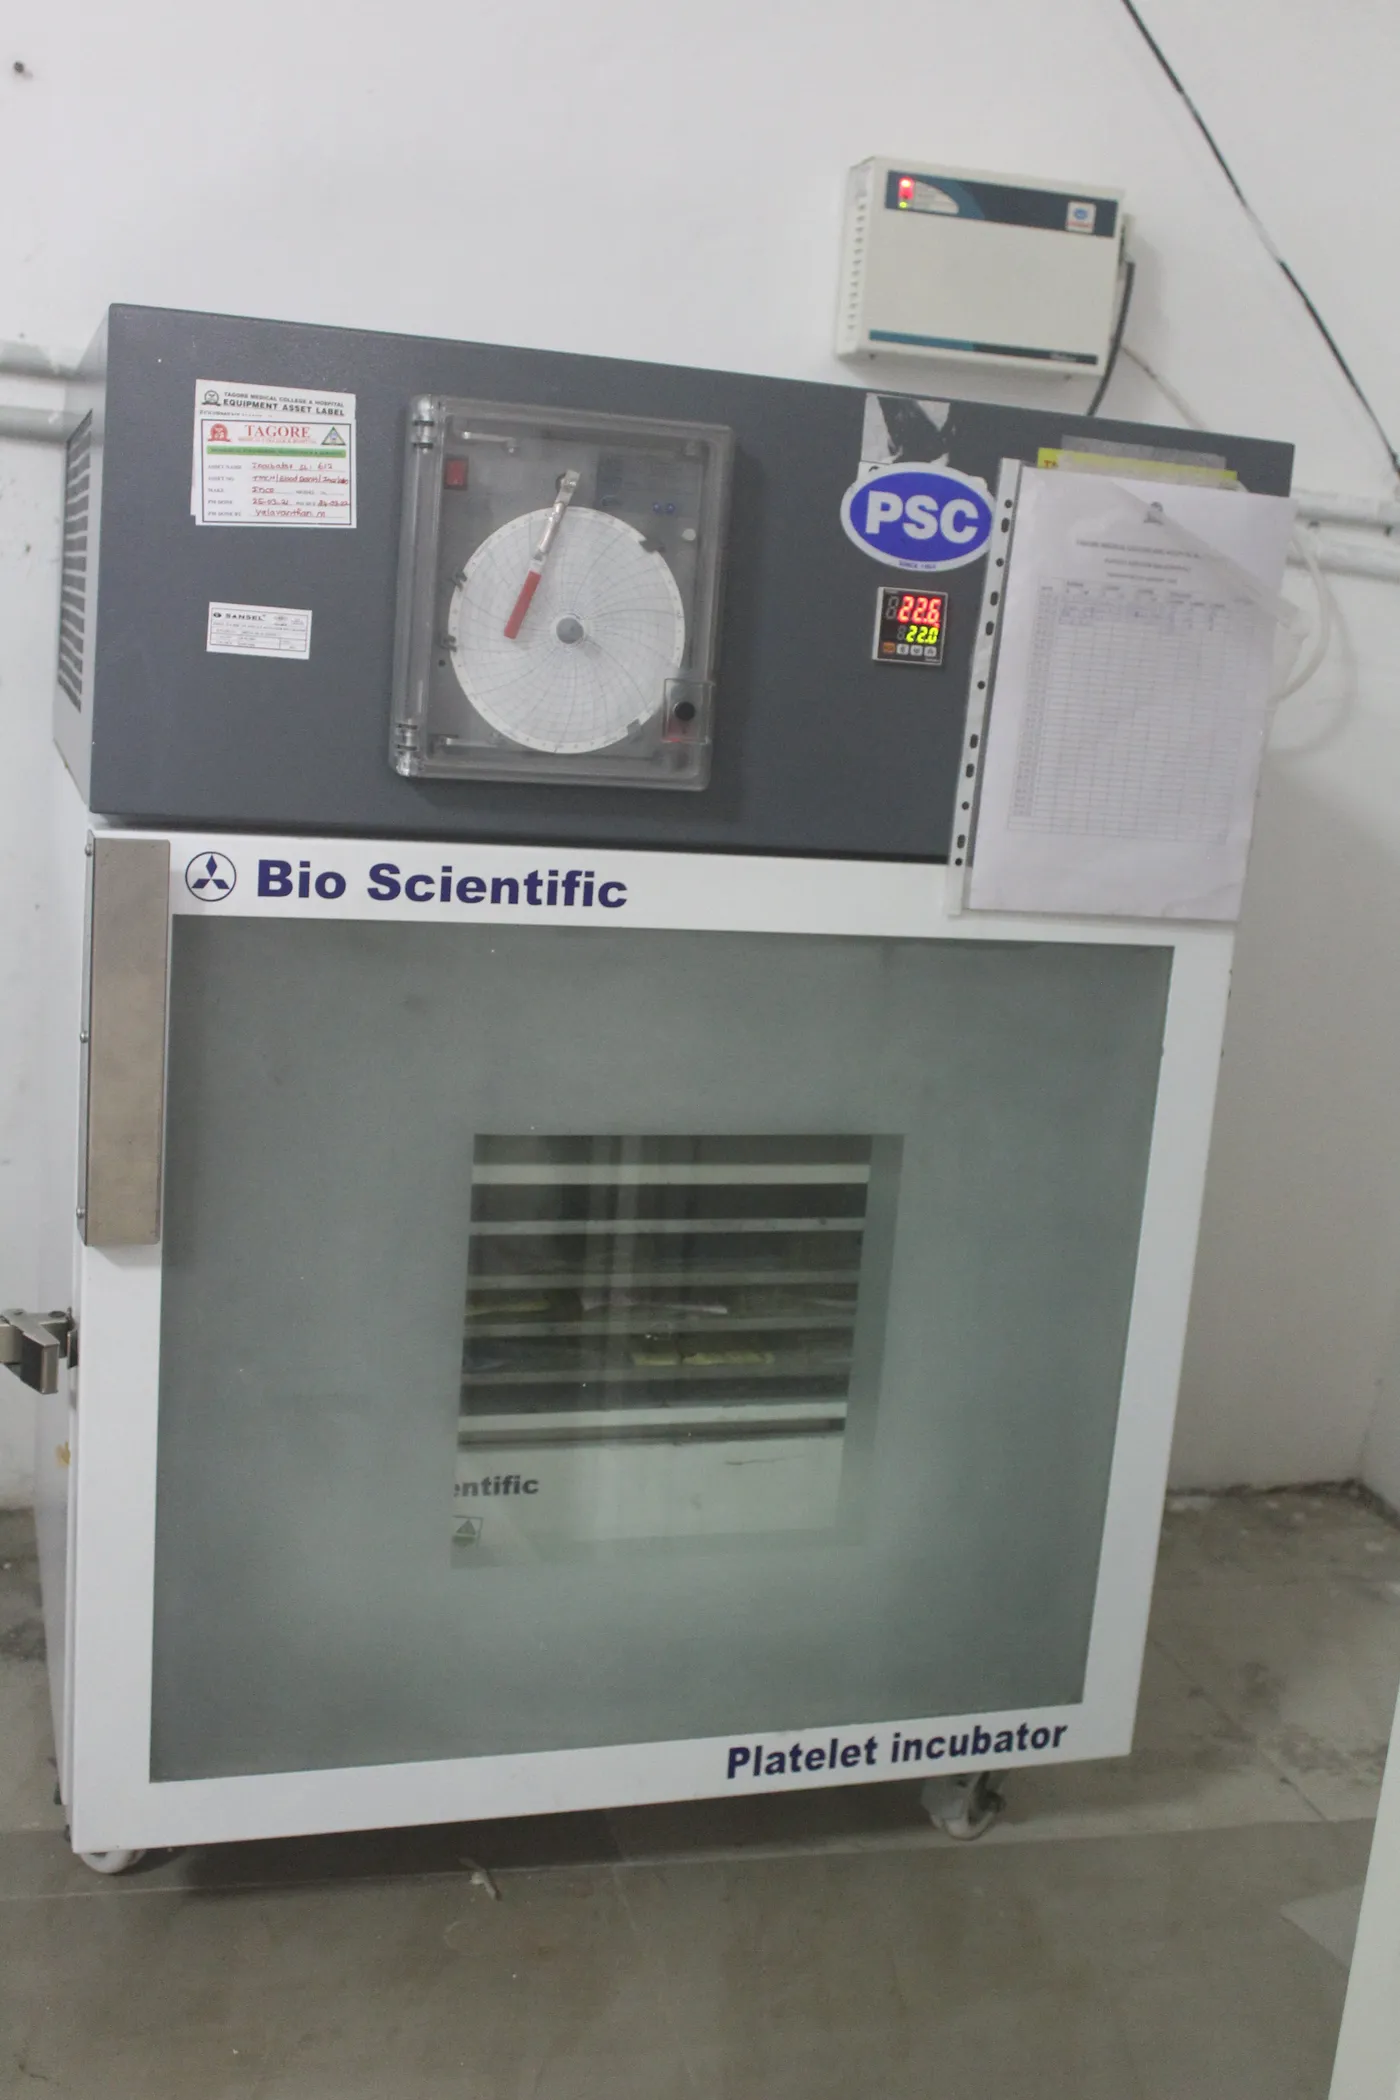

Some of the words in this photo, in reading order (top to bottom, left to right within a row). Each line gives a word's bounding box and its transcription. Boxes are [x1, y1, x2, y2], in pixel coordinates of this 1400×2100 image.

[223, 398, 278, 410] EQUIPMENT
[282, 404, 311, 413] ASSET
[316, 407, 345, 417] LABEL
[224, 391, 248, 399] TAGORE
[251, 394, 277, 402] MEDICAL
[279, 396, 307, 404] COLLEGE
[315, 400, 344, 408] HOSPITAL
[244, 424, 311, 438] TAGORE
[865, 490, 980, 544] PSC
[225, 613, 265, 621] SANSEL
[898, 595, 942, 624] 22.6
[905, 625, 940, 644] 22.0
[257, 859, 346, 900] Bio
[367, 862, 628, 909] Scientific
[727, 1736, 879, 1780] Platelet
[891, 1722, 1068, 1764] incubator
